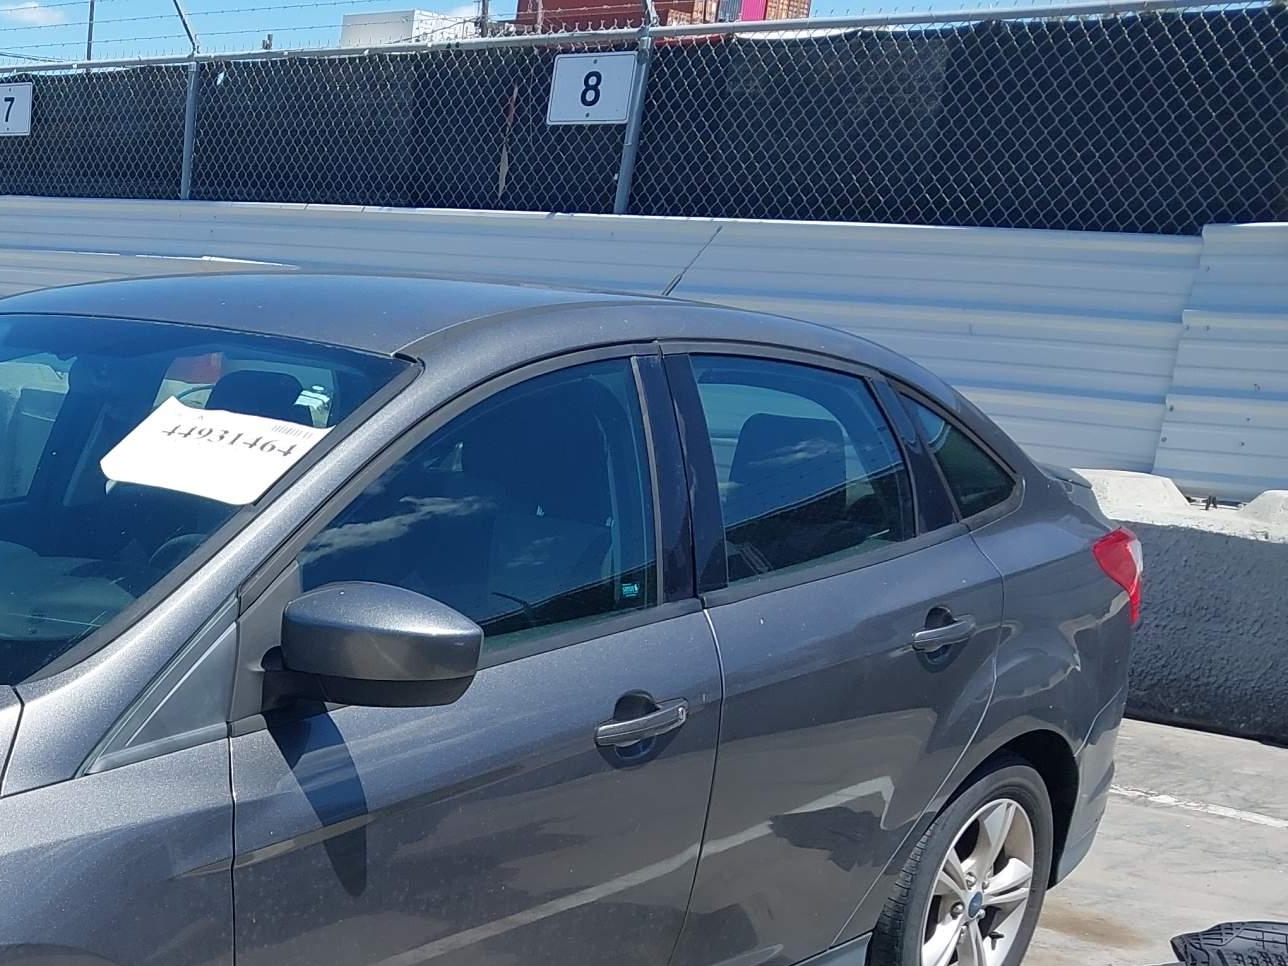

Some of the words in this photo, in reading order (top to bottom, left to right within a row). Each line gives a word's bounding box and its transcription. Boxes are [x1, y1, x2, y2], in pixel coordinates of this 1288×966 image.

[580, 70, 602, 107] 8
[4, 96, 15, 123] 7
[161, 424, 297, 457] 44931464
